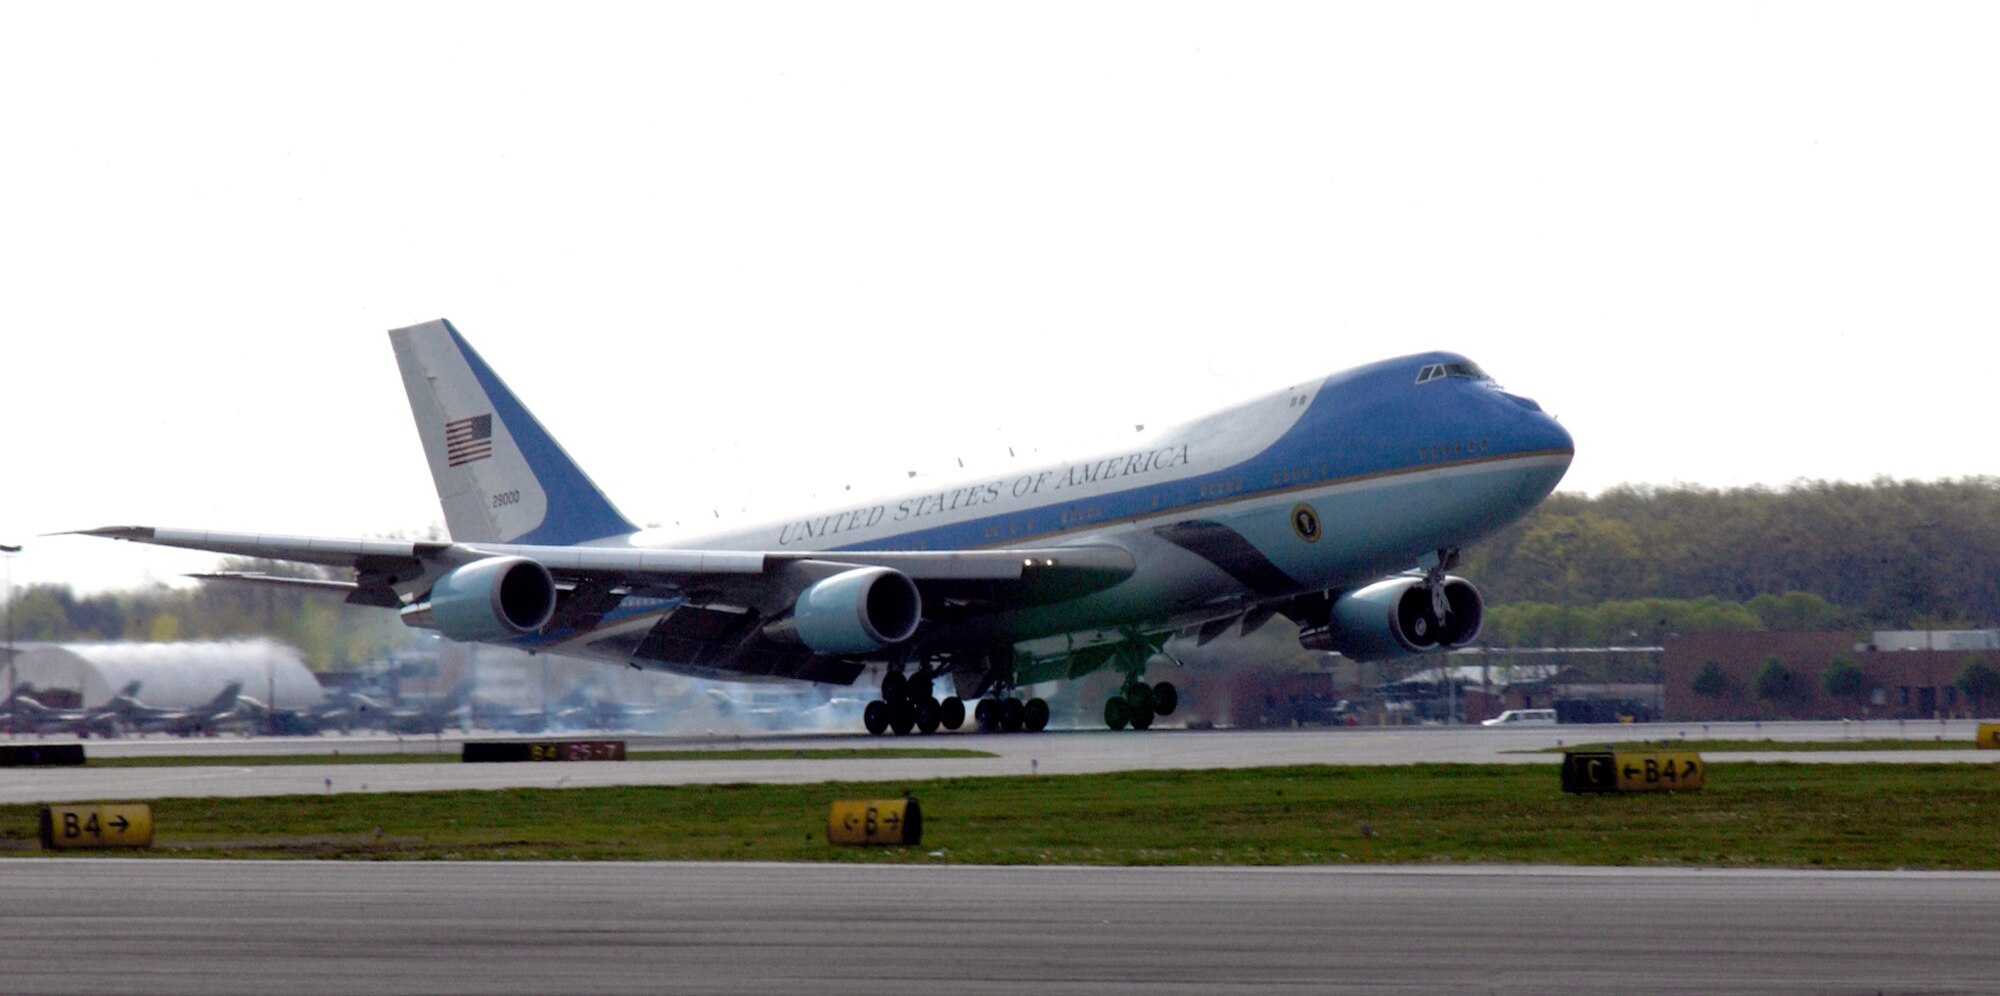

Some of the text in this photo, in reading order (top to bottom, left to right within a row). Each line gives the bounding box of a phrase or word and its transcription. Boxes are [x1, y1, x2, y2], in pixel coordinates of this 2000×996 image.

[492, 490, 520, 508] 29000
[778, 443, 1189, 545] UNITED STATES OF AMERICA
[1588, 759, 1676, 783] C B4
[63, 812, 101, 838] B4
